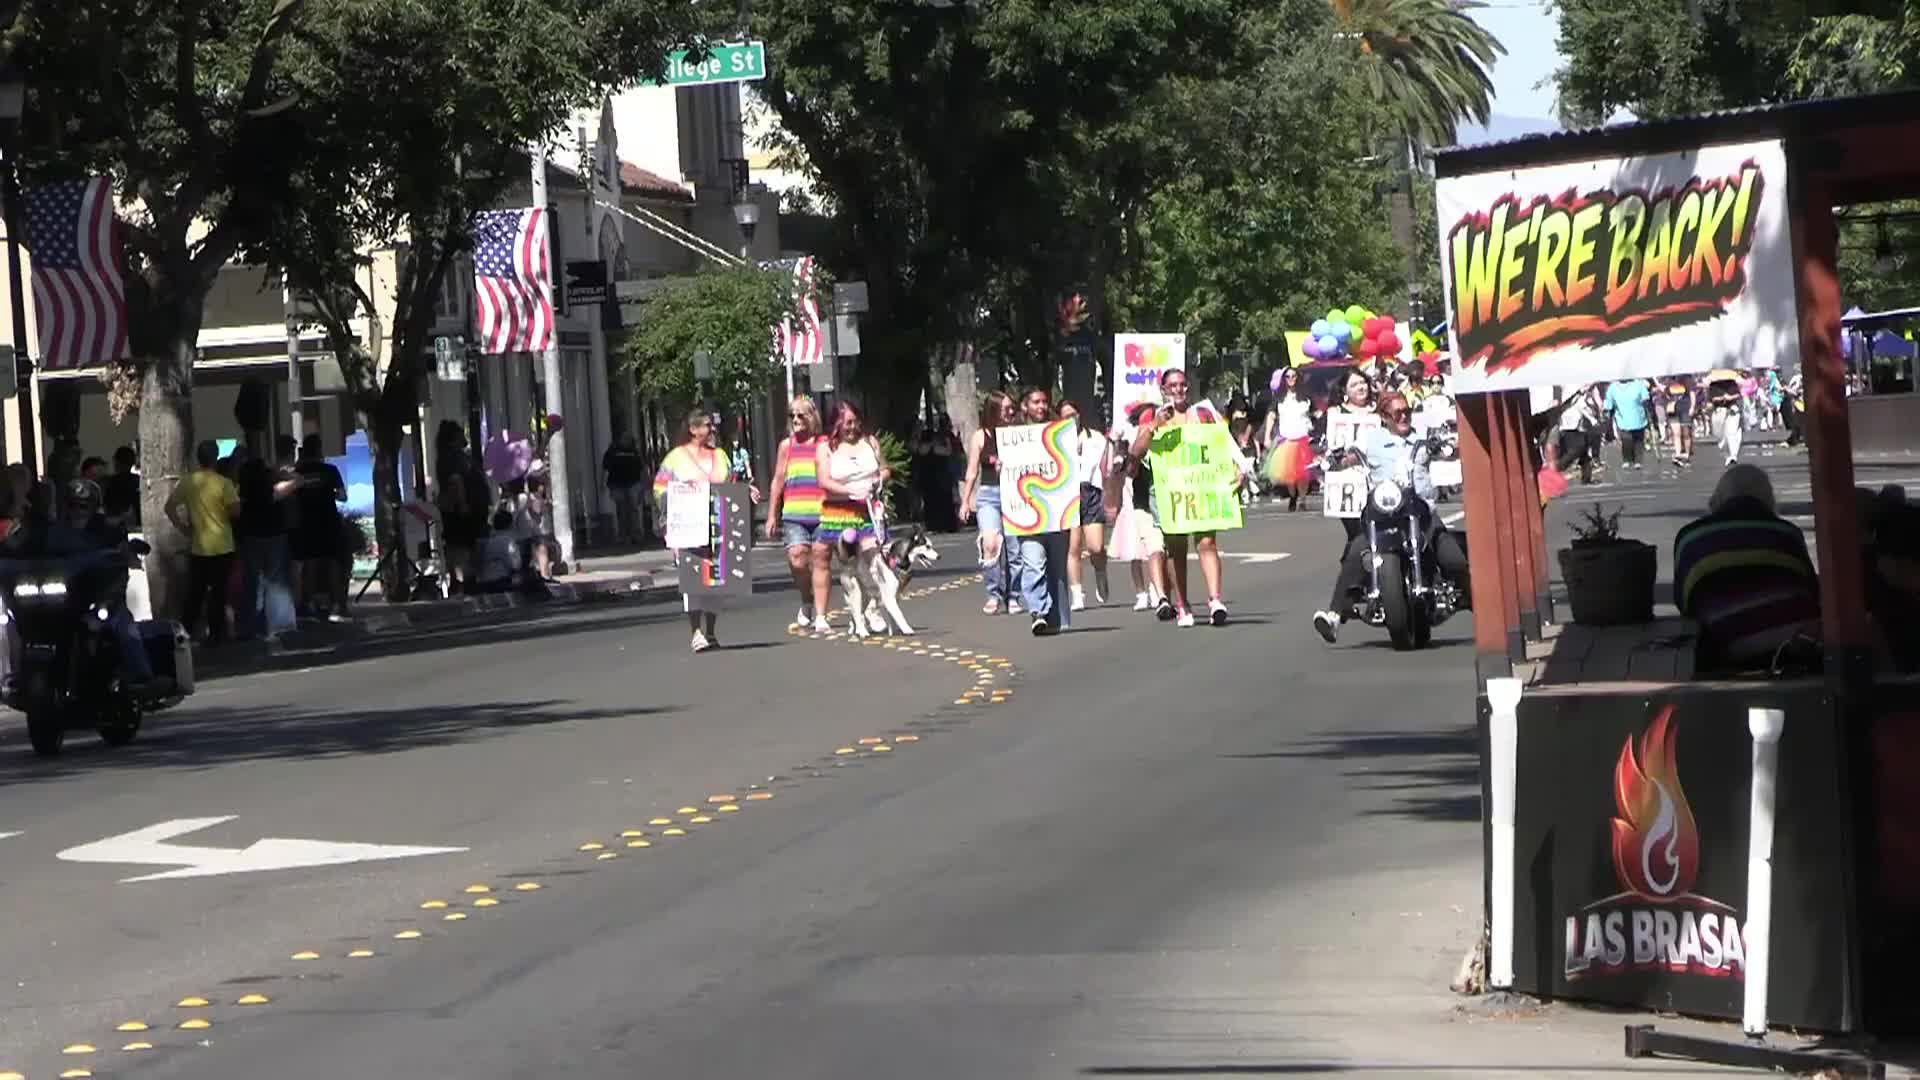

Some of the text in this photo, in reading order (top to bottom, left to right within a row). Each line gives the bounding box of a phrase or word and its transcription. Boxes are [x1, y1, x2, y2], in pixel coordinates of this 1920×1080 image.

[730, 50, 754, 73] St
[1452, 168, 1760, 337] WE'RE BACK!
[1002, 429, 1034, 447] LOVE
[1565, 911, 1626, 975] LAS
